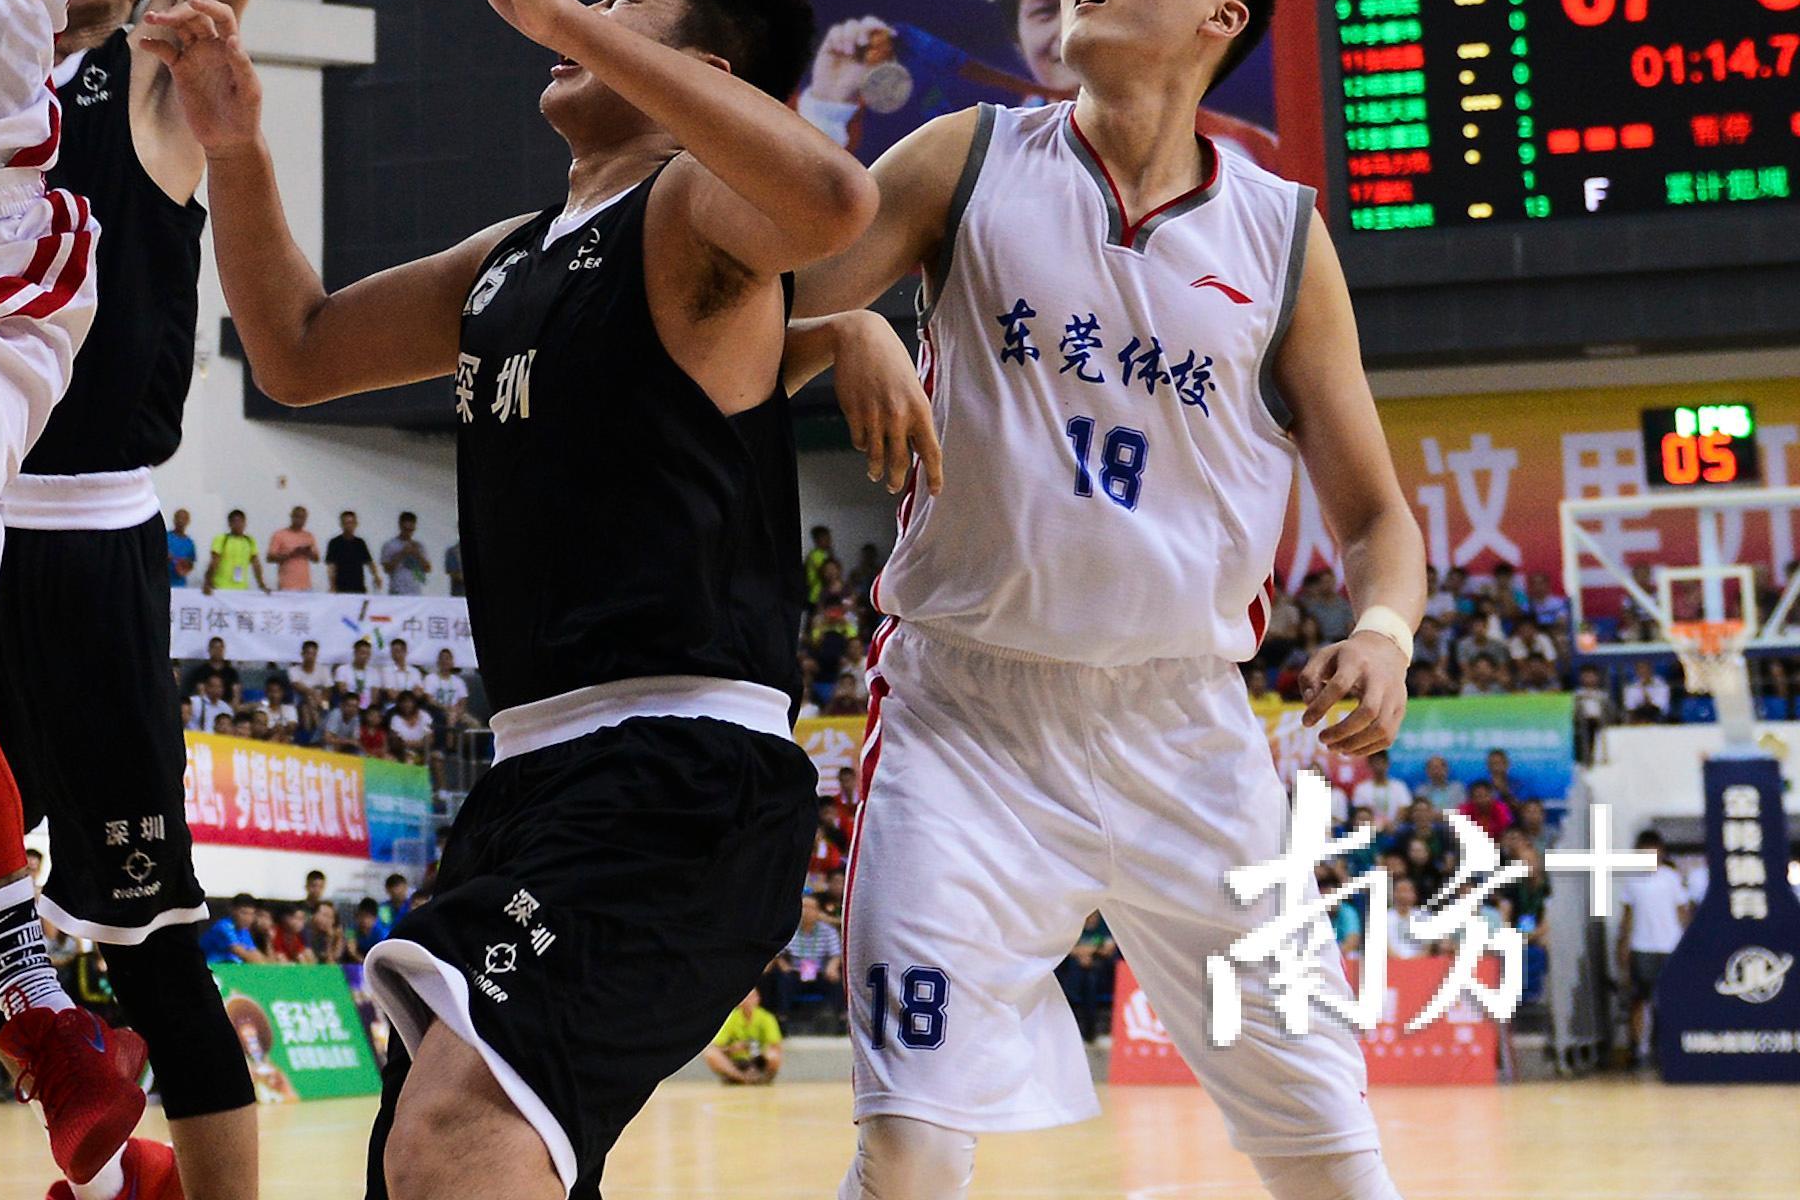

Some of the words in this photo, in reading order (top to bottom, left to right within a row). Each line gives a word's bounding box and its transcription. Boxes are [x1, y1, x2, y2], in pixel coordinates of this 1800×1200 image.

[1630, 33, 1800, 88] 01:14.7
[1583, 176, 1611, 212] F
[997, 298, 1217, 417] 东莞体校
[1065, 415, 1149, 513] 18
[1661, 431, 1738, 485] 05
[170, 607, 312, 634] 国体育彩票
[503, 888, 556, 956] 深圳
[465, 962, 509, 1004] ORER
[865, 962, 950, 1051] 18
